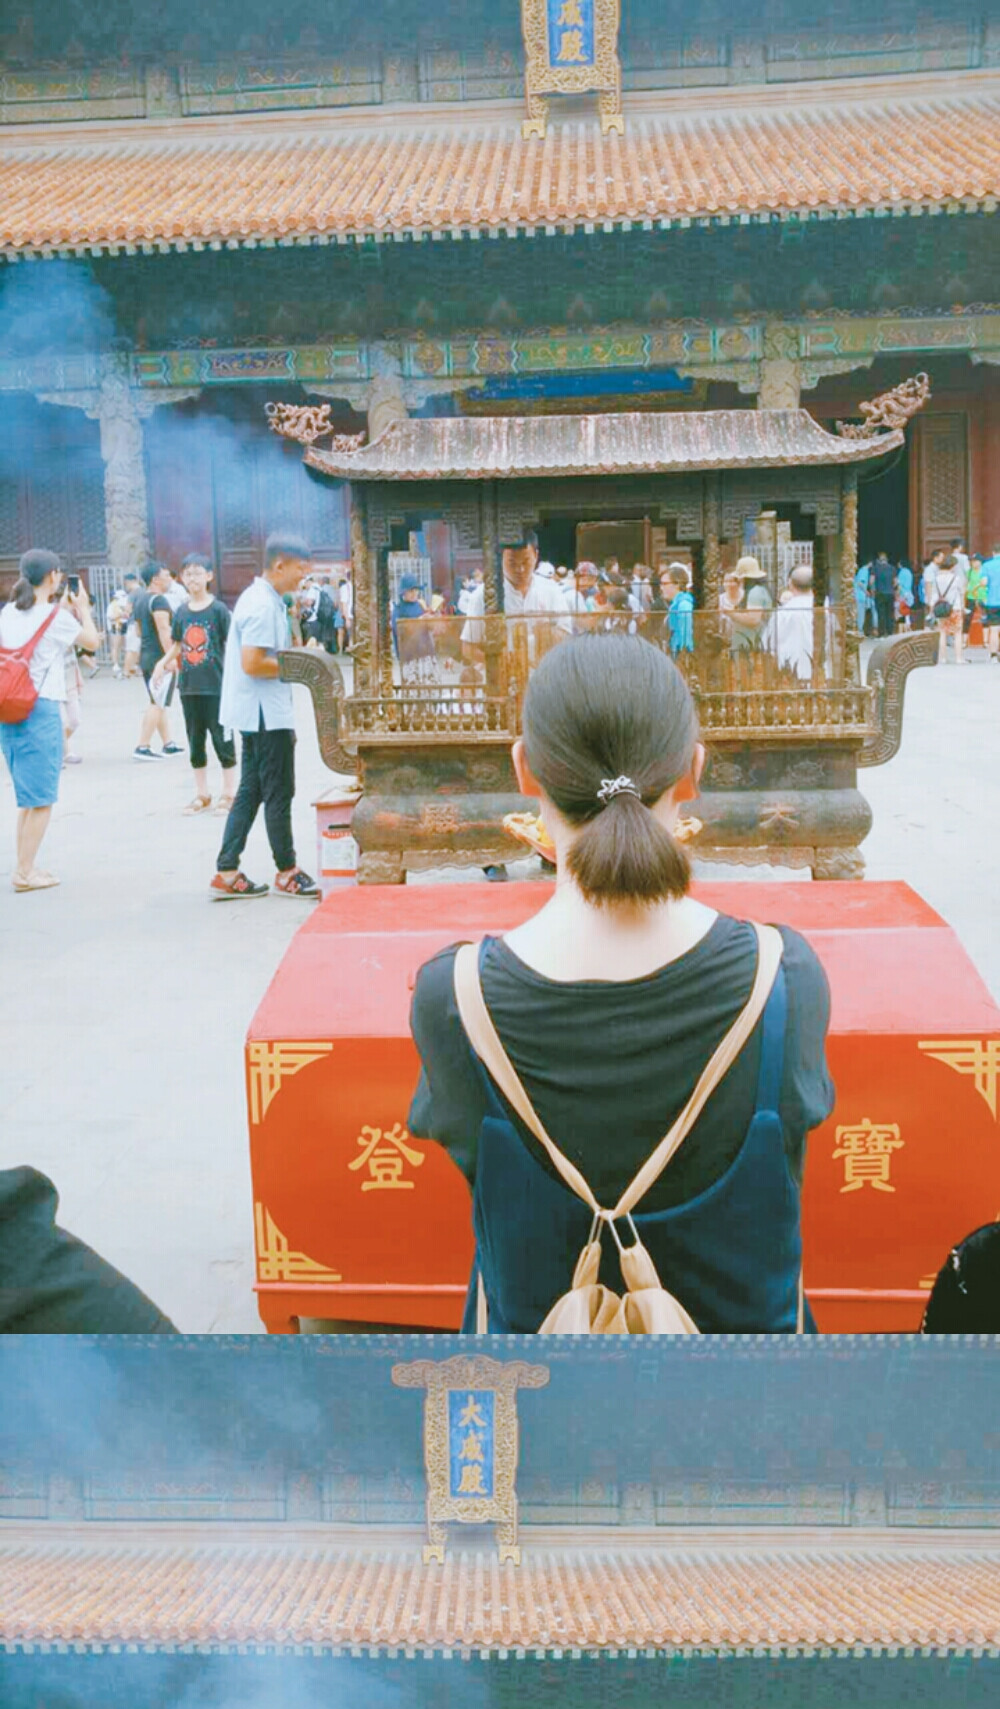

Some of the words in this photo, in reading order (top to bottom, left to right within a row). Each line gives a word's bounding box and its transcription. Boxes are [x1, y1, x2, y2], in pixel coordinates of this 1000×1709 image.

[347, 1121, 426, 1192] 登
[831, 1117, 906, 1193] 寶
[456, 1394, 489, 1494] 大成殿
